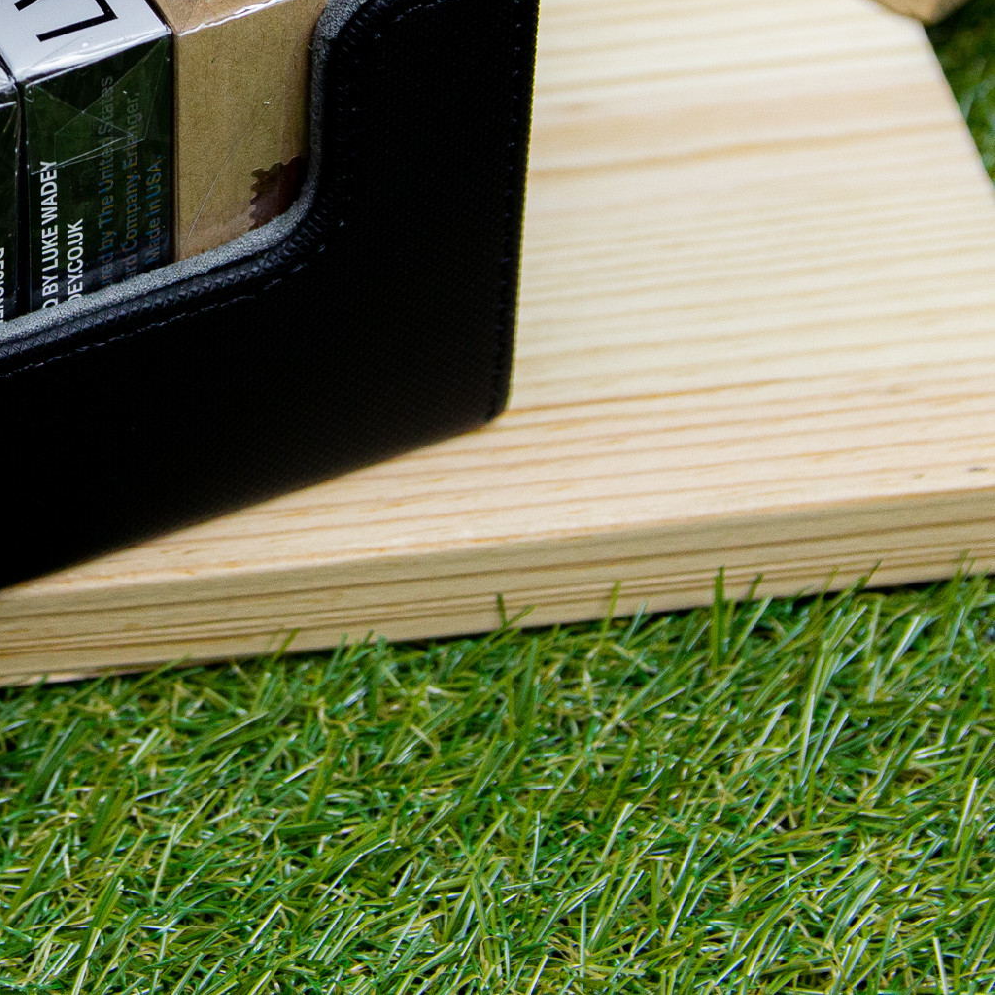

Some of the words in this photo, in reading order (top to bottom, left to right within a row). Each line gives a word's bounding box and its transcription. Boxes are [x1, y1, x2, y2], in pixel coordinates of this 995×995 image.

[97, 137, 114, 195] United
[39, 161, 58, 225] WADEY
[98, 195, 114, 229] The
[145, 200, 161, 218] in
[41, 225, 59, 272] LUKE
[98, 231, 117, 251] by
[144, 217, 161, 266] Made
[41, 274, 59, 297] BY
